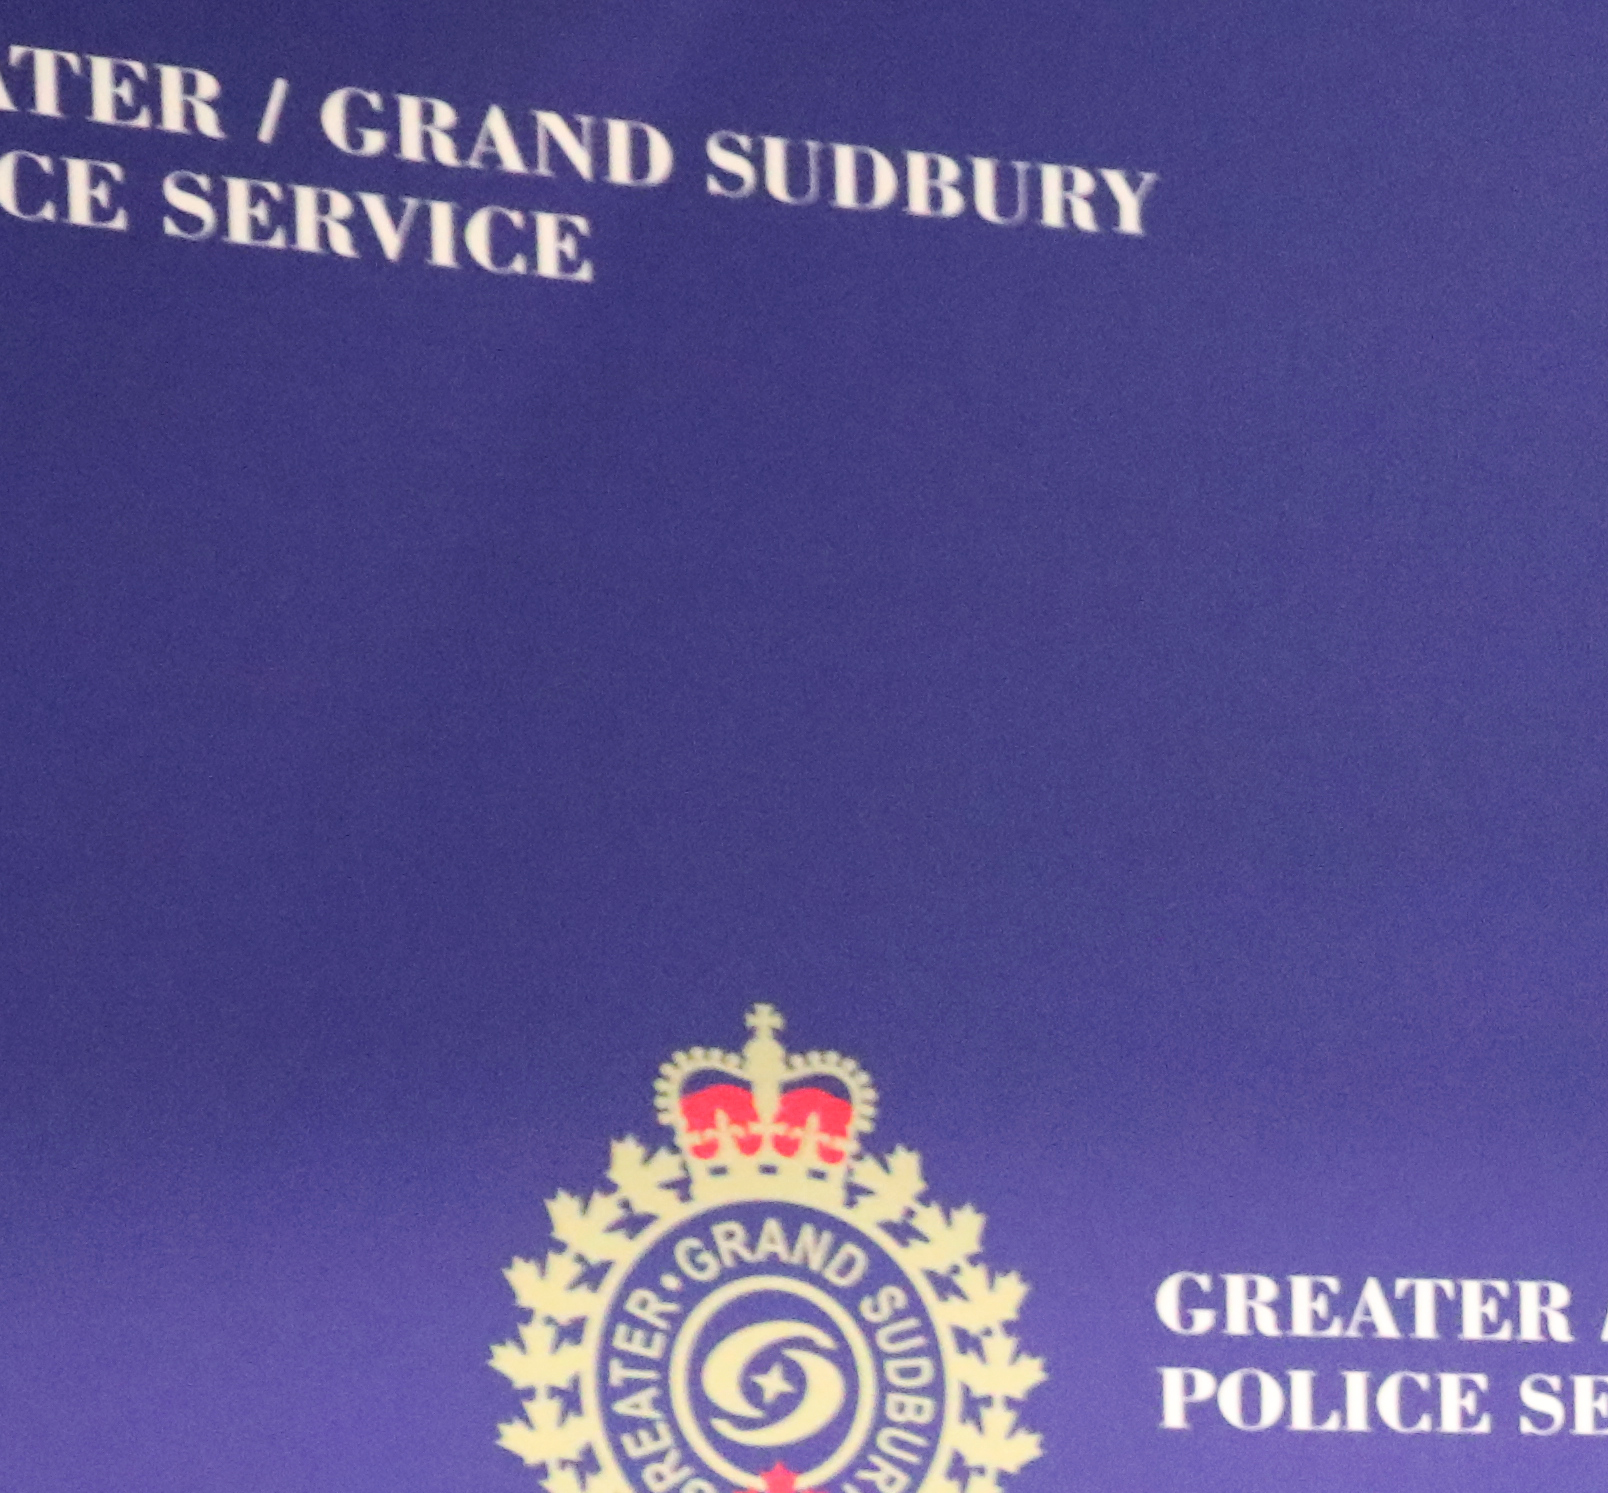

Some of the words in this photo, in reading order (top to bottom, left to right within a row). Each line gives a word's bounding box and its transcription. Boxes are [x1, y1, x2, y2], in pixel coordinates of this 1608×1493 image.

[258, 78, 289, 143] /
[321, 87, 673, 186] GRAND
[706, 131, 1156, 236] SUDBURY
[163, 171, 592, 282] SERVICE
[674, 1218, 868, 1287] GRAND
[1155, 1271, 1575, 1343] GREATER
[1159, 1367, 1491, 1434] POLICE
